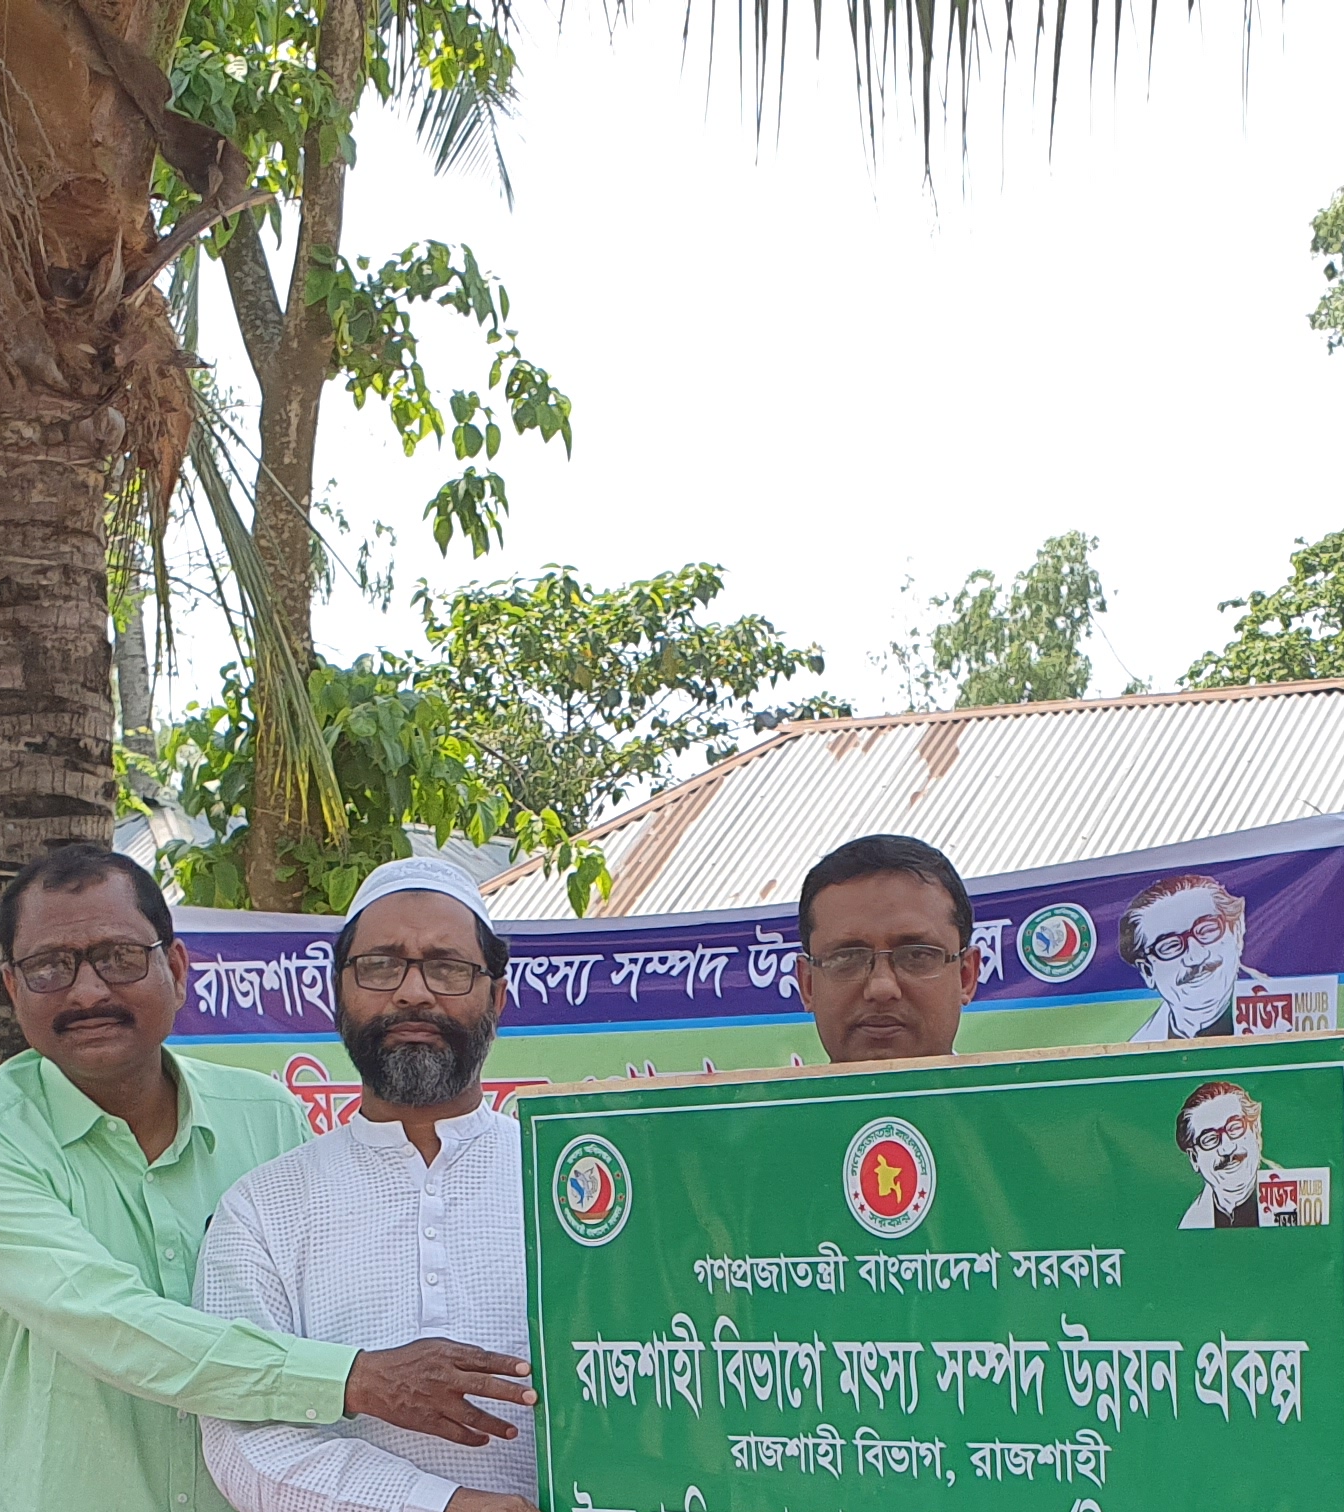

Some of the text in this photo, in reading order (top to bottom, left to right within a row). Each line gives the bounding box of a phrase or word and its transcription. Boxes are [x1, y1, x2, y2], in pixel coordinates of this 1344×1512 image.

[190, 941, 337, 1023] রাজশাহী
[504, 953, 605, 1008] মৎস্য
[610, 943, 739, 1002] সম্পদ
[1294, 991, 1329, 1013] MUJIB
[1298, 1179, 1323, 1197] MUJIB
[1298, 1198, 1323, 1226] 100
[692, 1240, 1127, 1296] গণপ্রজাতন্ত্রী বাংলাদেশ সরকার
[570, 1311, 1311, 1433] রাজশাহী বিভাগে মৎস্য সম্পদ উন্নয়ন প্রকল্প
[726, 1422, 1113, 1488] রাজশাহী বিভাগ, রাজশাহী
